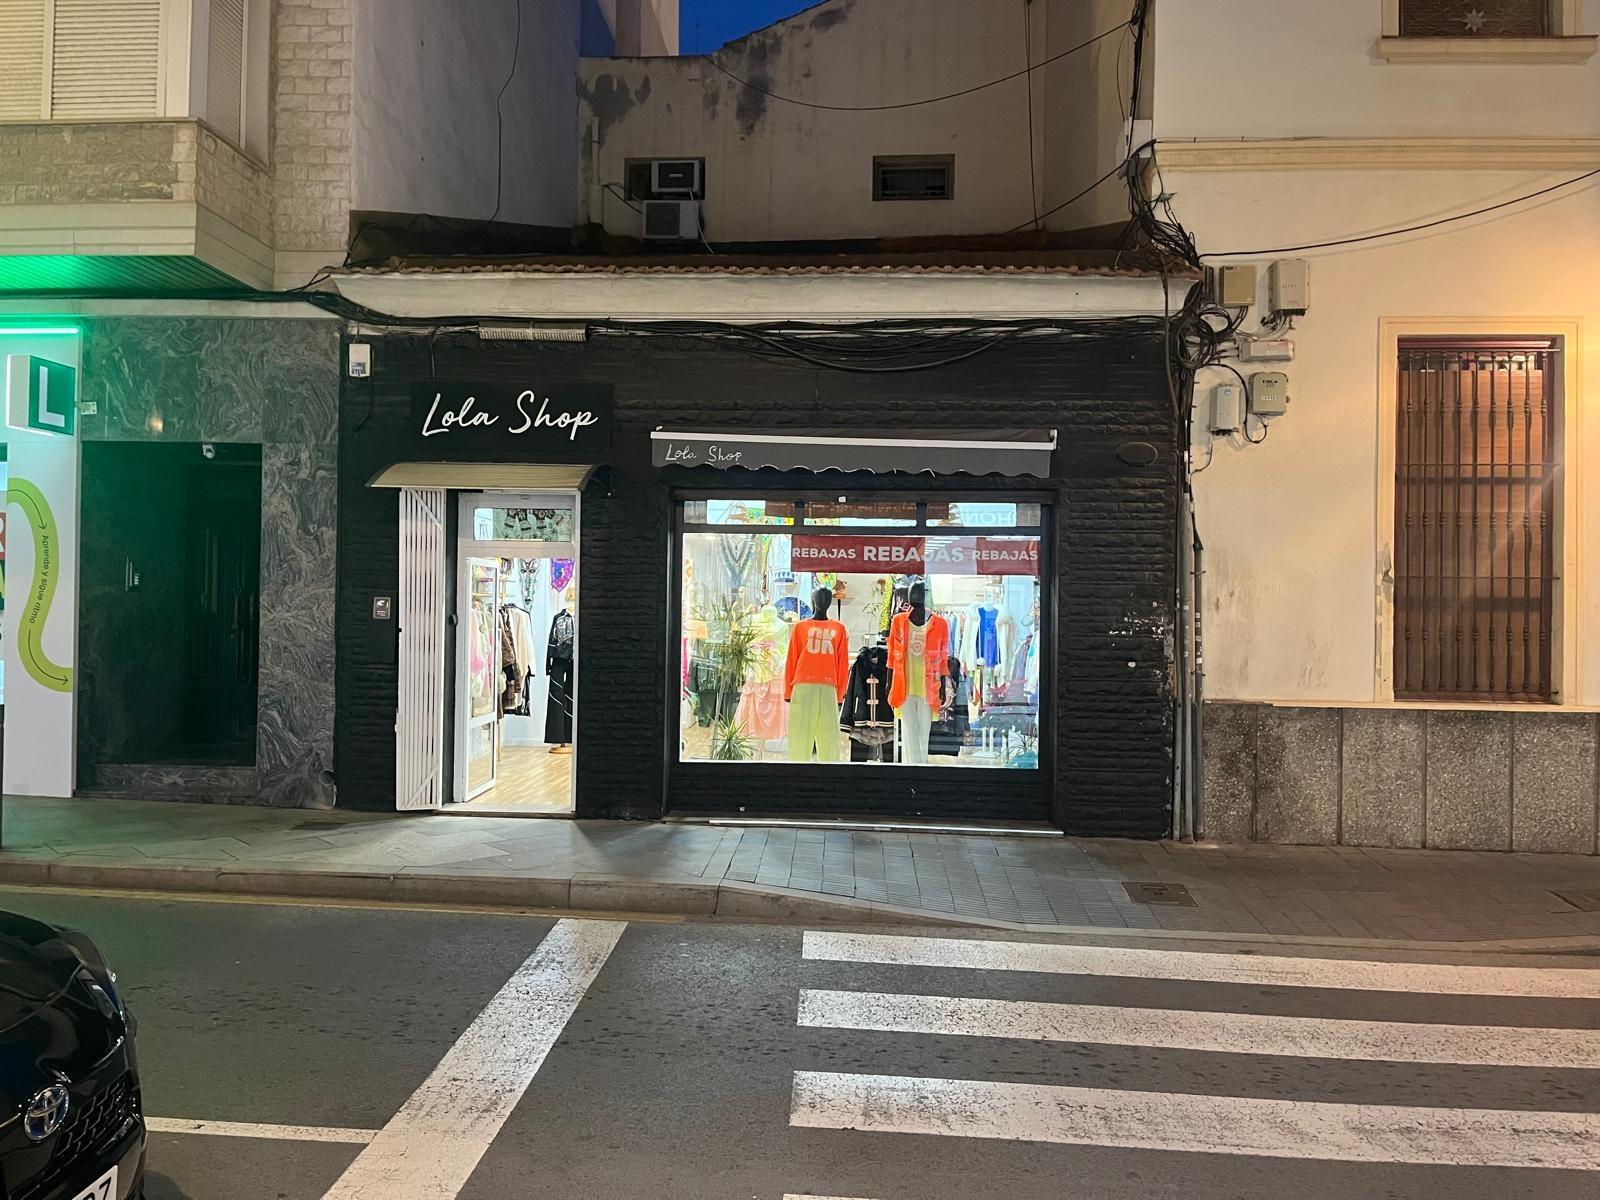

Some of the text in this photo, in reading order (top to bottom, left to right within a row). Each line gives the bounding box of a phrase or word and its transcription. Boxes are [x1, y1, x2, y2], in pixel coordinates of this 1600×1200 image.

[39, 366, 65, 427] L
[422, 390, 598, 440] Lola Shop
[665, 443, 742, 461] Lola Shop
[42, 534, 50, 569] Aprende
[792, 545, 1038, 562] REBAJAS REBAJAS REBAJAS
[37, 578, 48, 600] sigue
[30, 602, 41, 624] ritmo
[806, 626, 837, 655] OK
